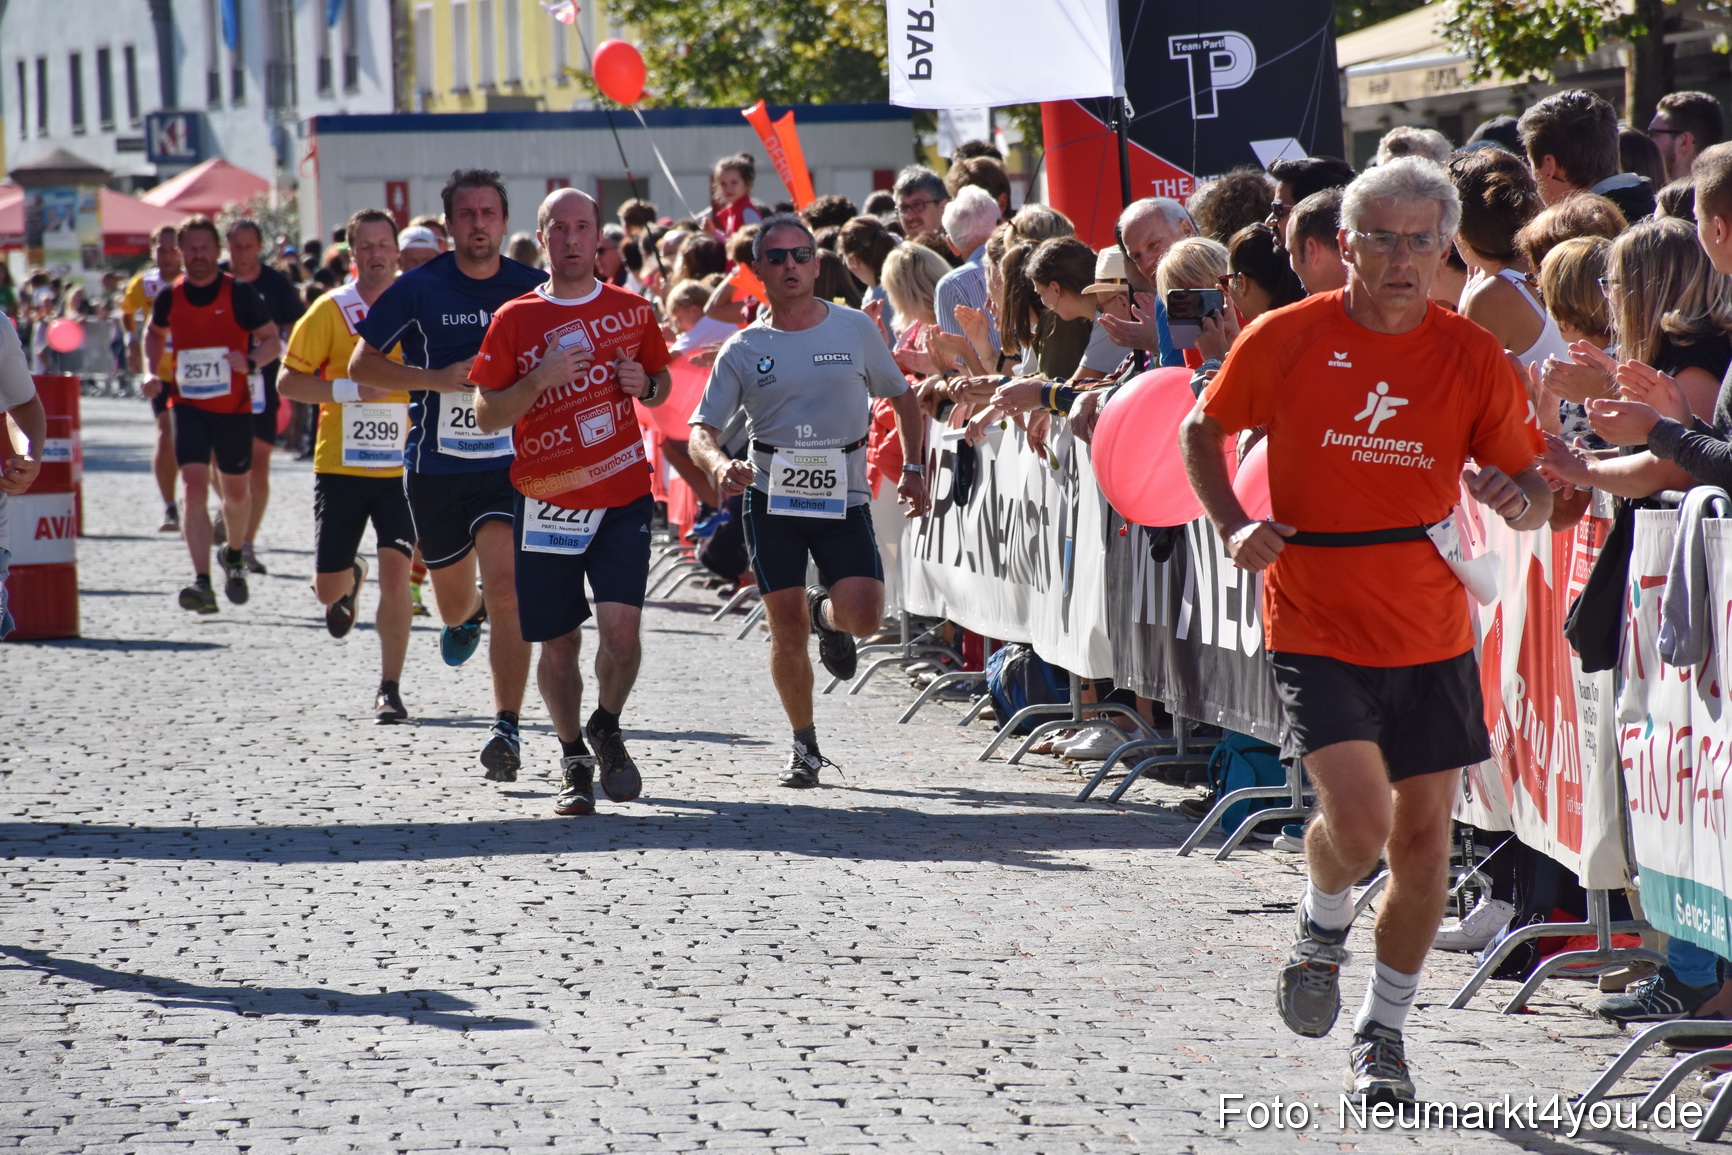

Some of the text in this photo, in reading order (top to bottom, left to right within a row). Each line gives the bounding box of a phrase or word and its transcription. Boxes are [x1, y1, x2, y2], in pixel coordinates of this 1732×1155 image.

[1175, 39, 1201, 52] Team
[1152, 178, 1191, 197] THE
[442, 313, 478, 326] EURO
[813, 353, 851, 364] BOCK
[1328, 360, 1352, 368] erima
[184, 361, 221, 379] 2571
[594, 382, 620, 399] outdo
[450, 406, 478, 429] 26
[577, 405, 611, 424] raumbox
[353, 421, 400, 441] 2399
[794, 424, 818, 439] 19.
[457, 441, 495, 452] Stephan
[1321, 429, 1424, 455] funrunners
[358, 451, 393, 461] Christian
[794, 455, 828, 464] BOCK
[1351, 449, 1436, 471] neumarkt
[517, 449, 634, 498] Team raumbox
[781, 467, 837, 490] 2265
[789, 498, 826, 511] Michael
[559, 525, 582, 533] Neumarkt
[549, 534, 579, 547] Tobias
[1464, 890, 1475, 912] now
